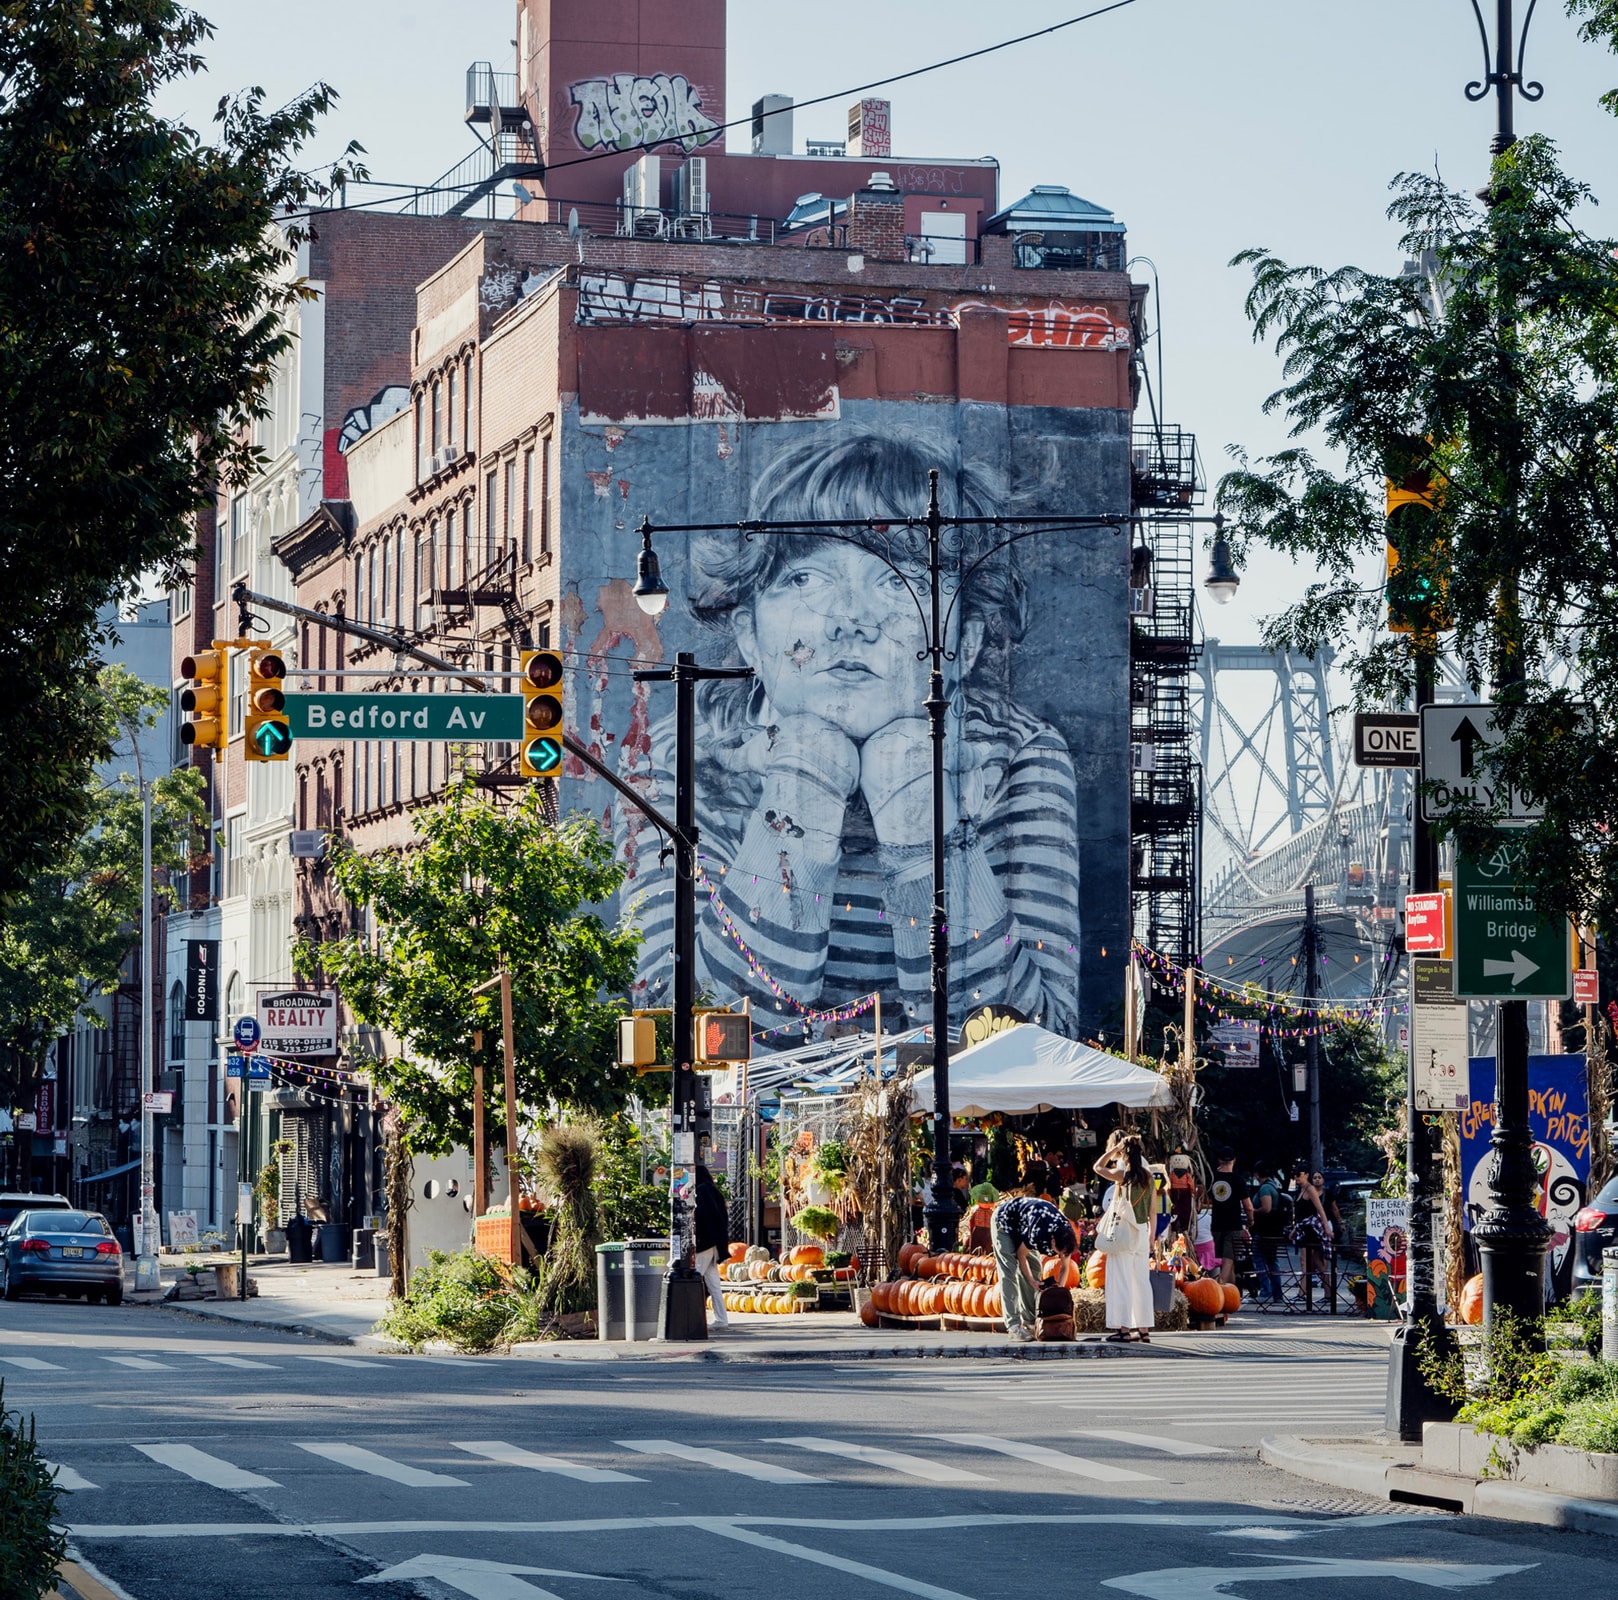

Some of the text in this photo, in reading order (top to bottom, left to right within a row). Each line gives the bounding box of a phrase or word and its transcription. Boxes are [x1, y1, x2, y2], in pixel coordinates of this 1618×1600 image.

[307, 704, 486, 729] Bedford Av
[1368, 730, 1417, 750] ONE
[1487, 921, 1537, 942] Bridge
[197, 968, 207, 1015] PINGPOD
[273, 998, 321, 1008] BROADWAY
[267, 1009, 326, 1026] REALTY
[41, 1085, 50, 1128] HARDWARE
[1546, 1112, 1590, 1160] PATCH
[1370, 1200, 1407, 1209] THE GREA
[1370, 1209, 1405, 1219] PUMPKIN
[1370, 1218, 1394, 1228] HERE!
